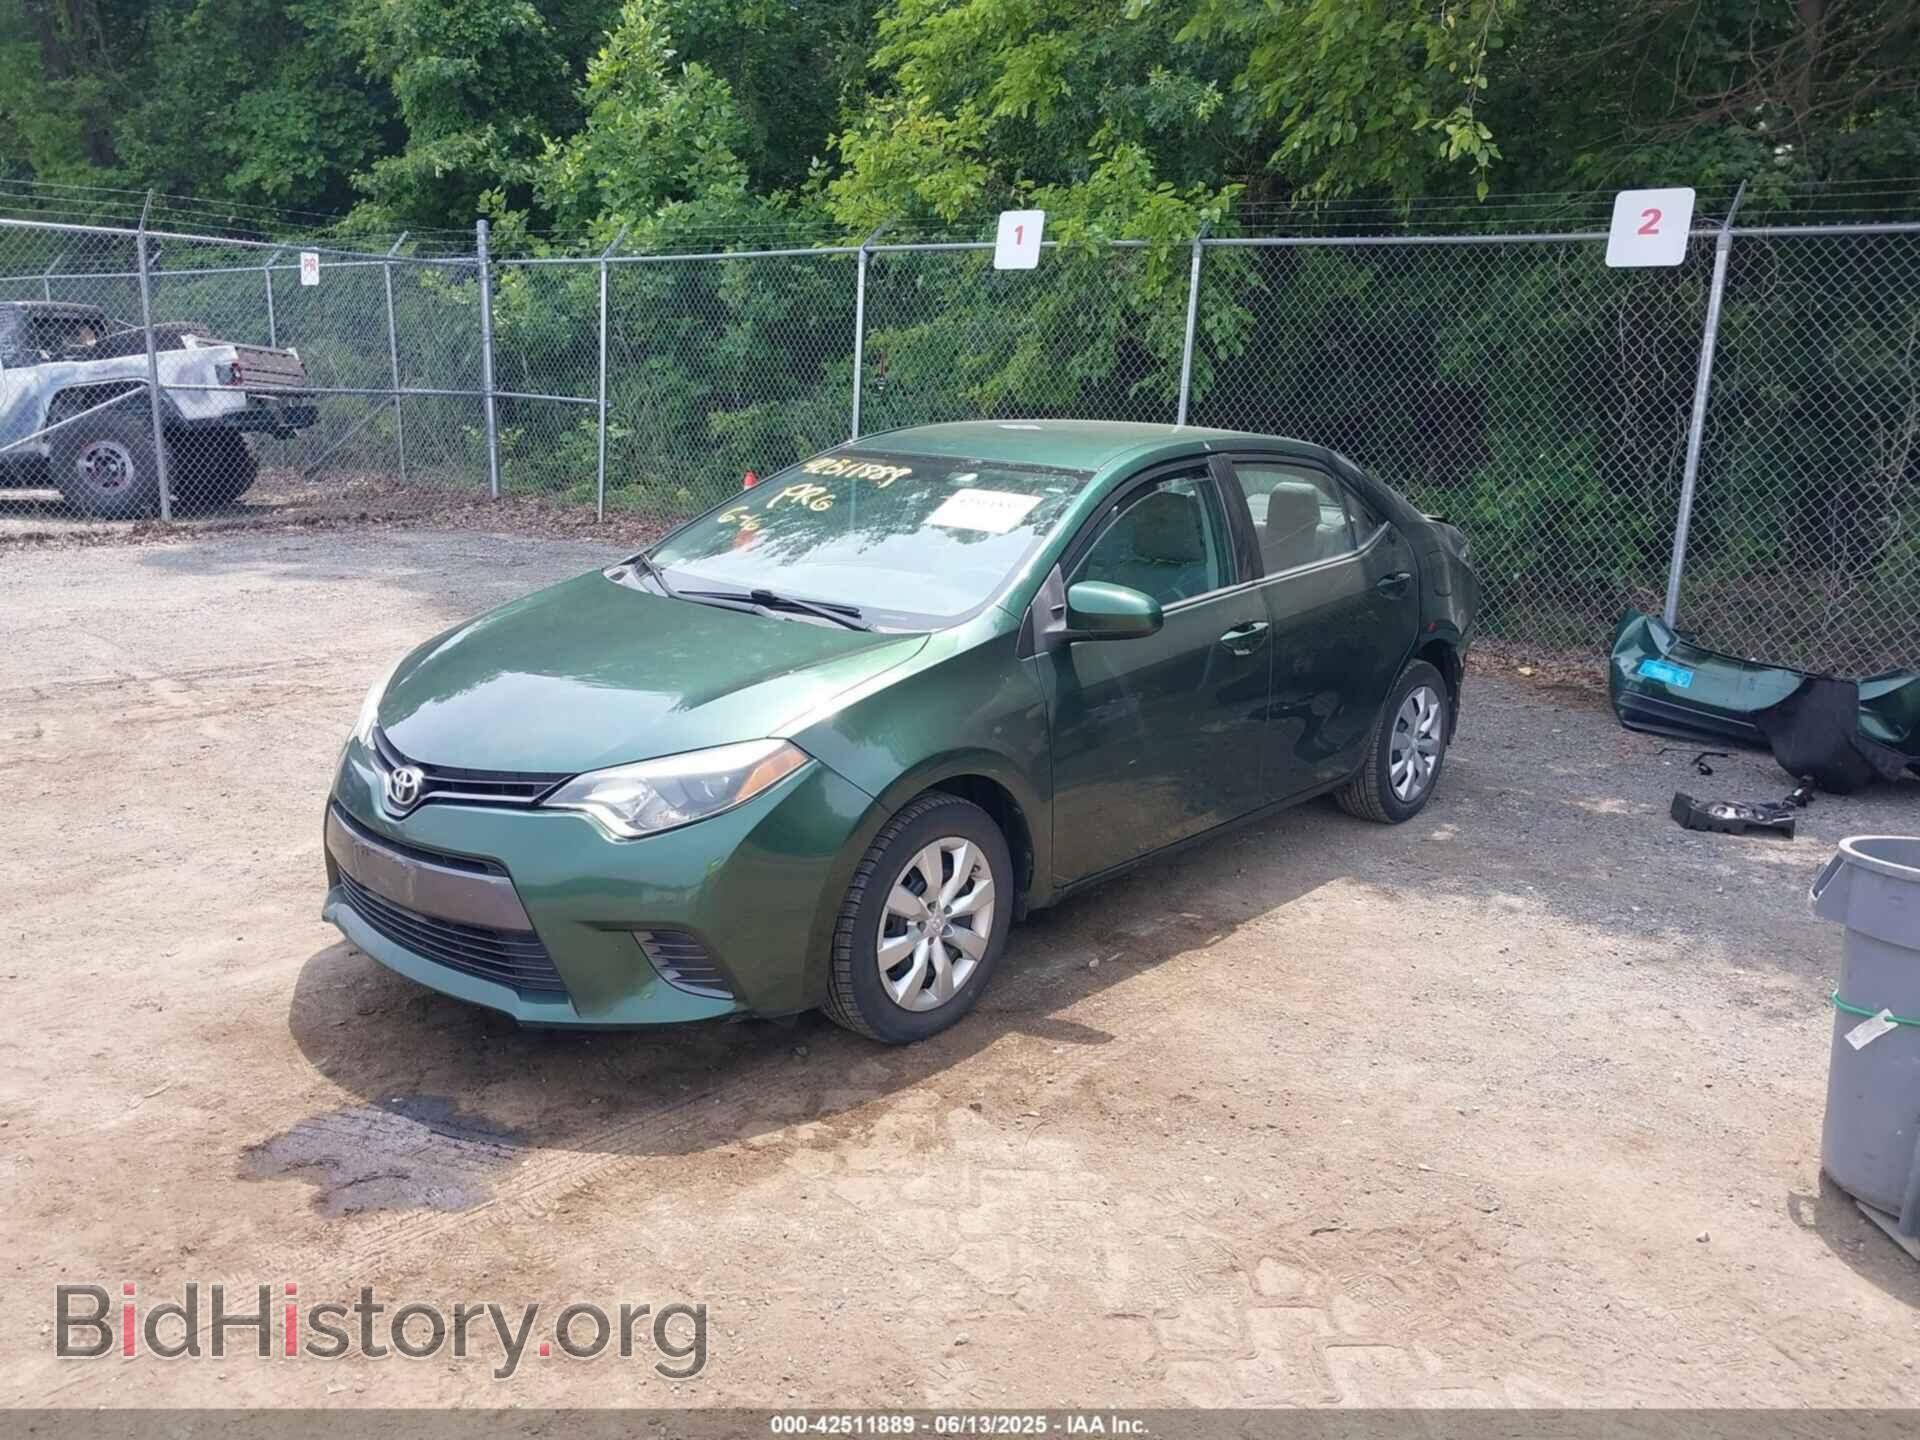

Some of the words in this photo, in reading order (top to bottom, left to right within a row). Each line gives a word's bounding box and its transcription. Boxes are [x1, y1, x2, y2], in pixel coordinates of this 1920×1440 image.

[1638, 208, 1662, 235] 2
[1014, 224, 1024, 246] 1
[303, 257, 317, 272] PR
